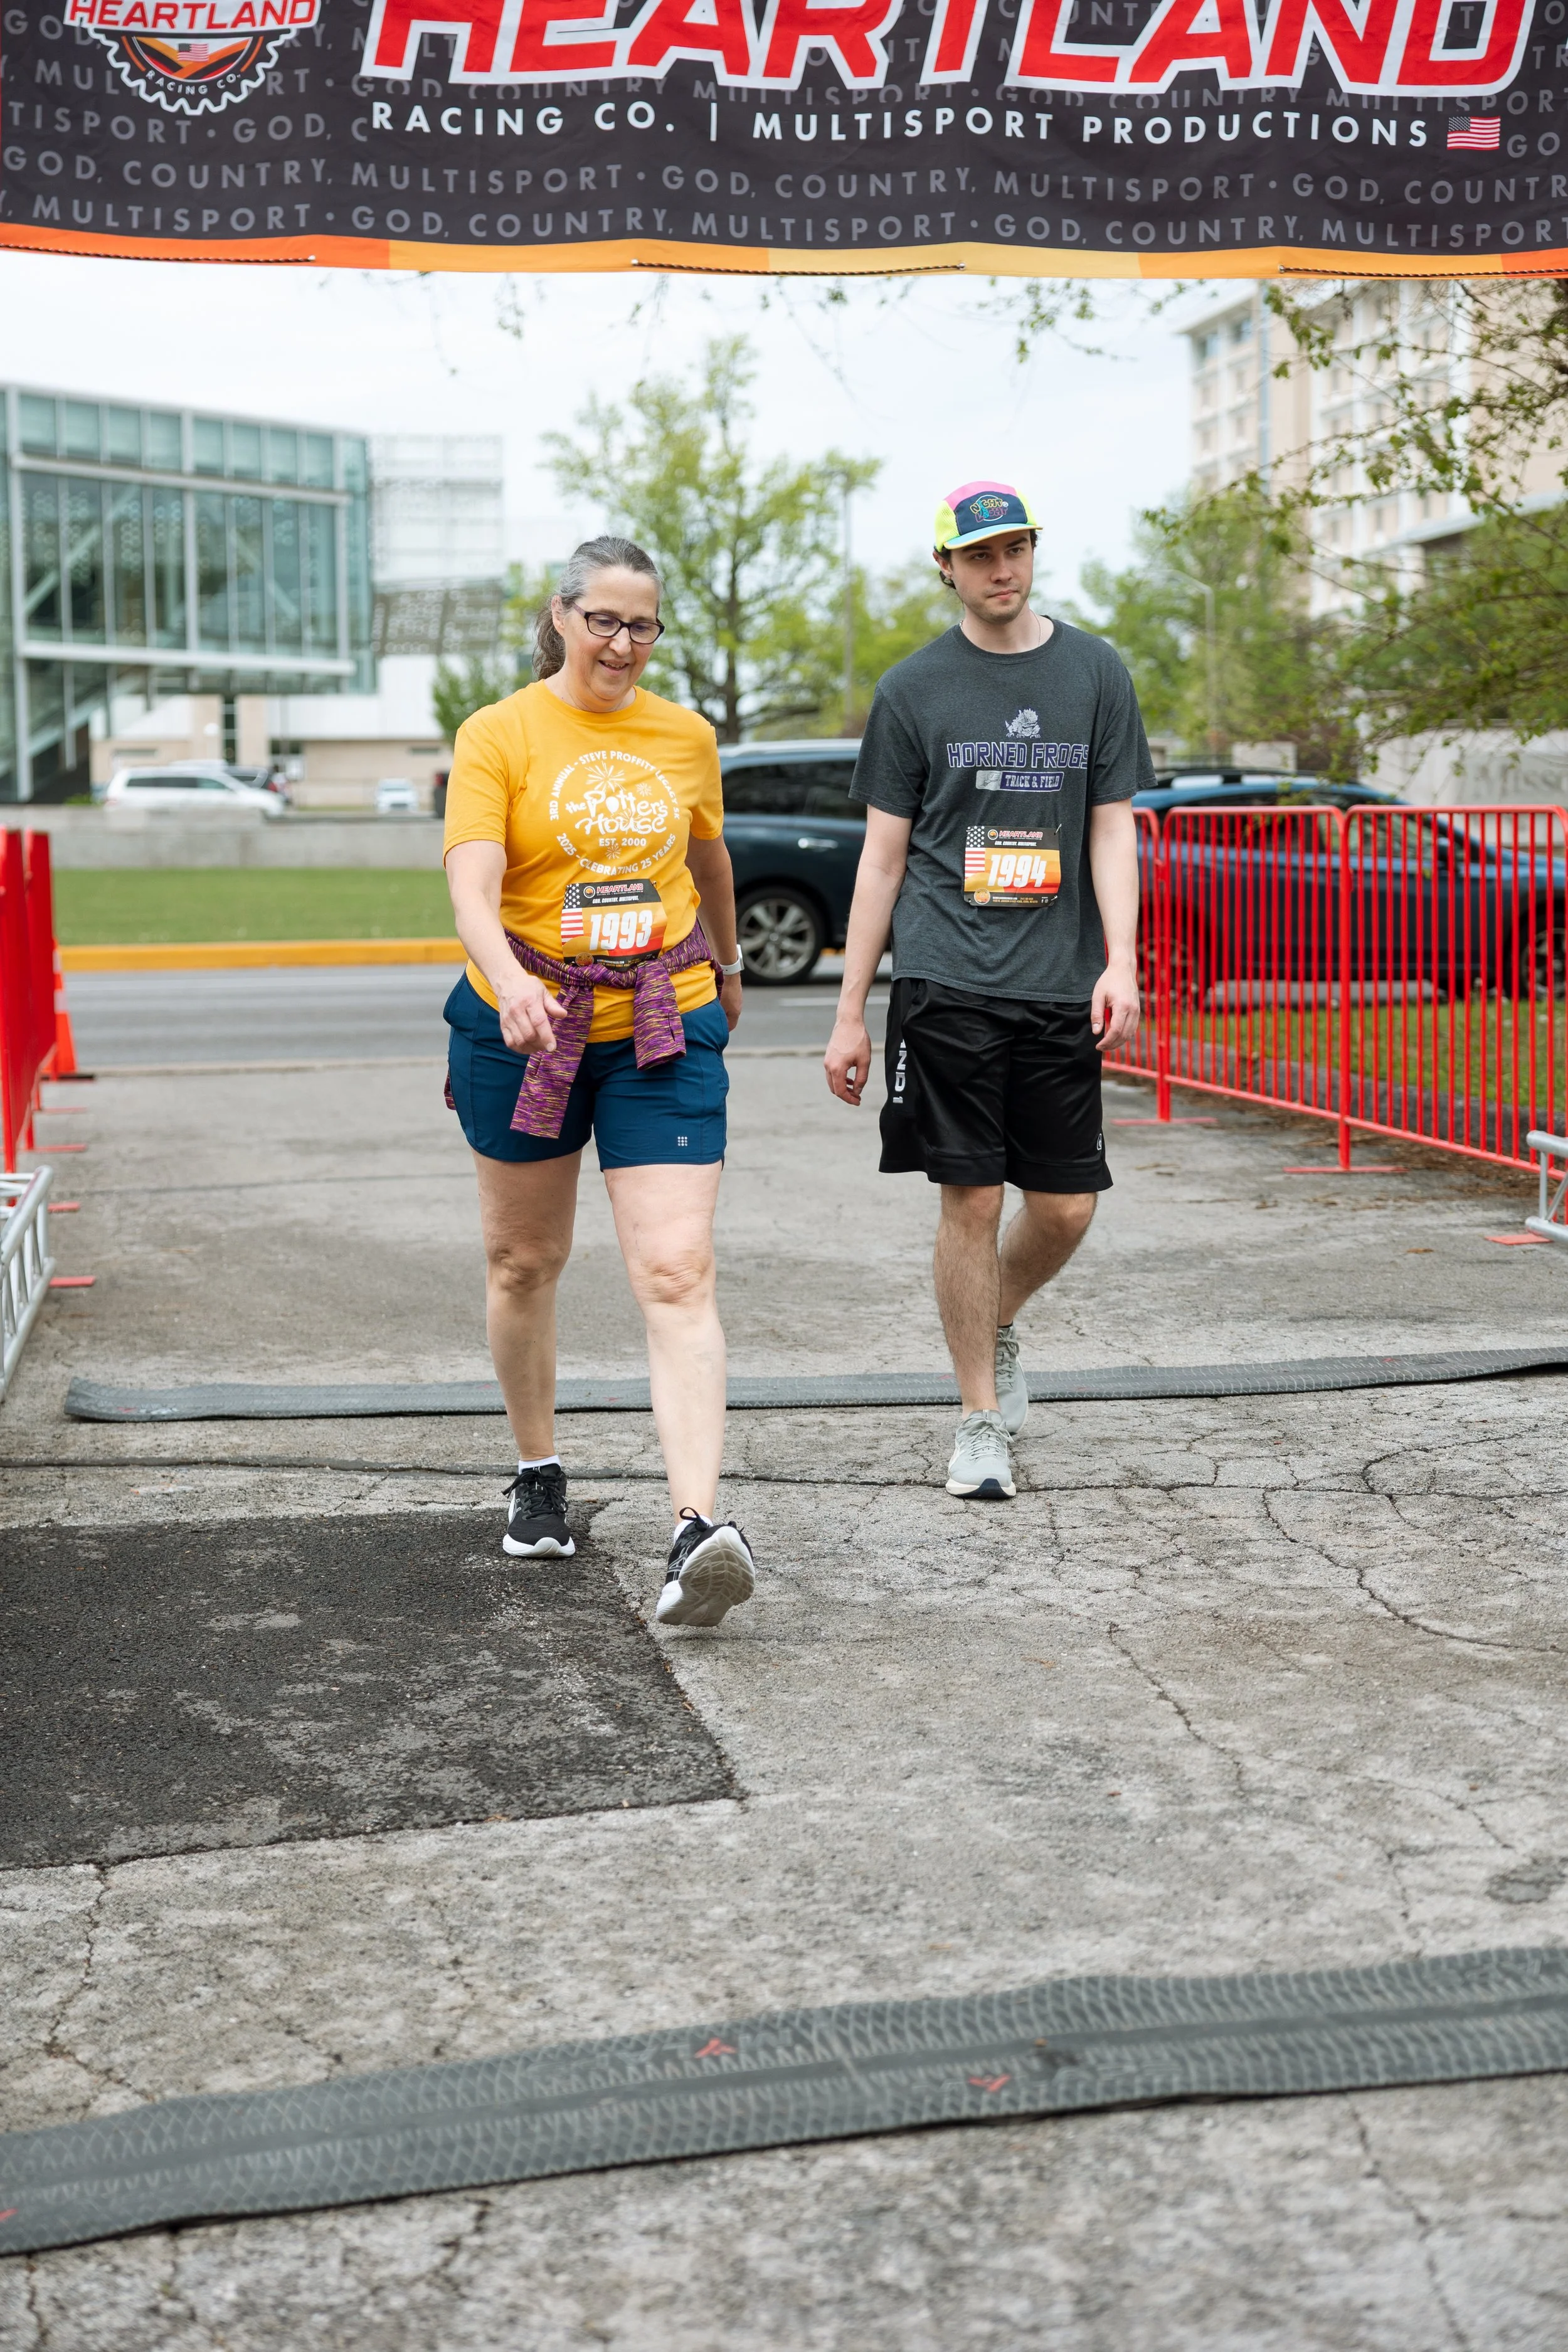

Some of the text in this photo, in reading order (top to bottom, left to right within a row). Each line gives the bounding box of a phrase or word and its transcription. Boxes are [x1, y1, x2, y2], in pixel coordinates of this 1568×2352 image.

[70, 0, 314, 29] HEARTLAND
[365, 0, 1534, 92] HEARTLAND
[146, 70, 208, 95] RACING
[233, 114, 331, 143] GOD,
[372, 102, 563, 135] RACING
[594, 101, 674, 132] CO.
[753, 106, 1053, 142] MULTISPORT
[1083, 111, 1427, 147] PRODUCTIONS
[3, 146, 102, 183] GOD,
[123, 158, 331, 188] COUNTRY,
[351, 161, 622, 194] MULTISPORT
[662, 165, 755, 198] GOD,
[775, 167, 976, 199] COUNTRY,
[994, 170, 1254, 202] MULTISPORT
[1293, 172, 1384, 205] GOD,
[32, 194, 311, 233] MULTISPORT
[351, 205, 449, 238] GOD,
[469, 208, 672, 238] COUNTRY,
[692, 211, 955, 241] MULTISPORT
[994, 213, 1086, 245] GOD,
[1106, 215, 1303, 245] COUNTRY,
[578, 751, 607, 765] STEVE
[610, 751, 656, 771] PROFFITT
[947, 742, 1027, 768] HORNED
[551, 765, 575, 798] ANNUAL
[655, 770, 678, 805] LEGACY
[1005, 775, 1060, 788] TRACK & FIELD
[549, 800, 559, 820] 3RD
[565, 801, 587, 813] the
[556, 833, 577, 856] 2025
[640, 857, 652, 870] 25
[652, 833, 676, 861] YEARS
[599, 837, 647, 847] EST. 2000
[987, 854, 1047, 887] 1994
[596, 883, 644, 894] HEARTLAND
[588, 909, 653, 951] 1993
